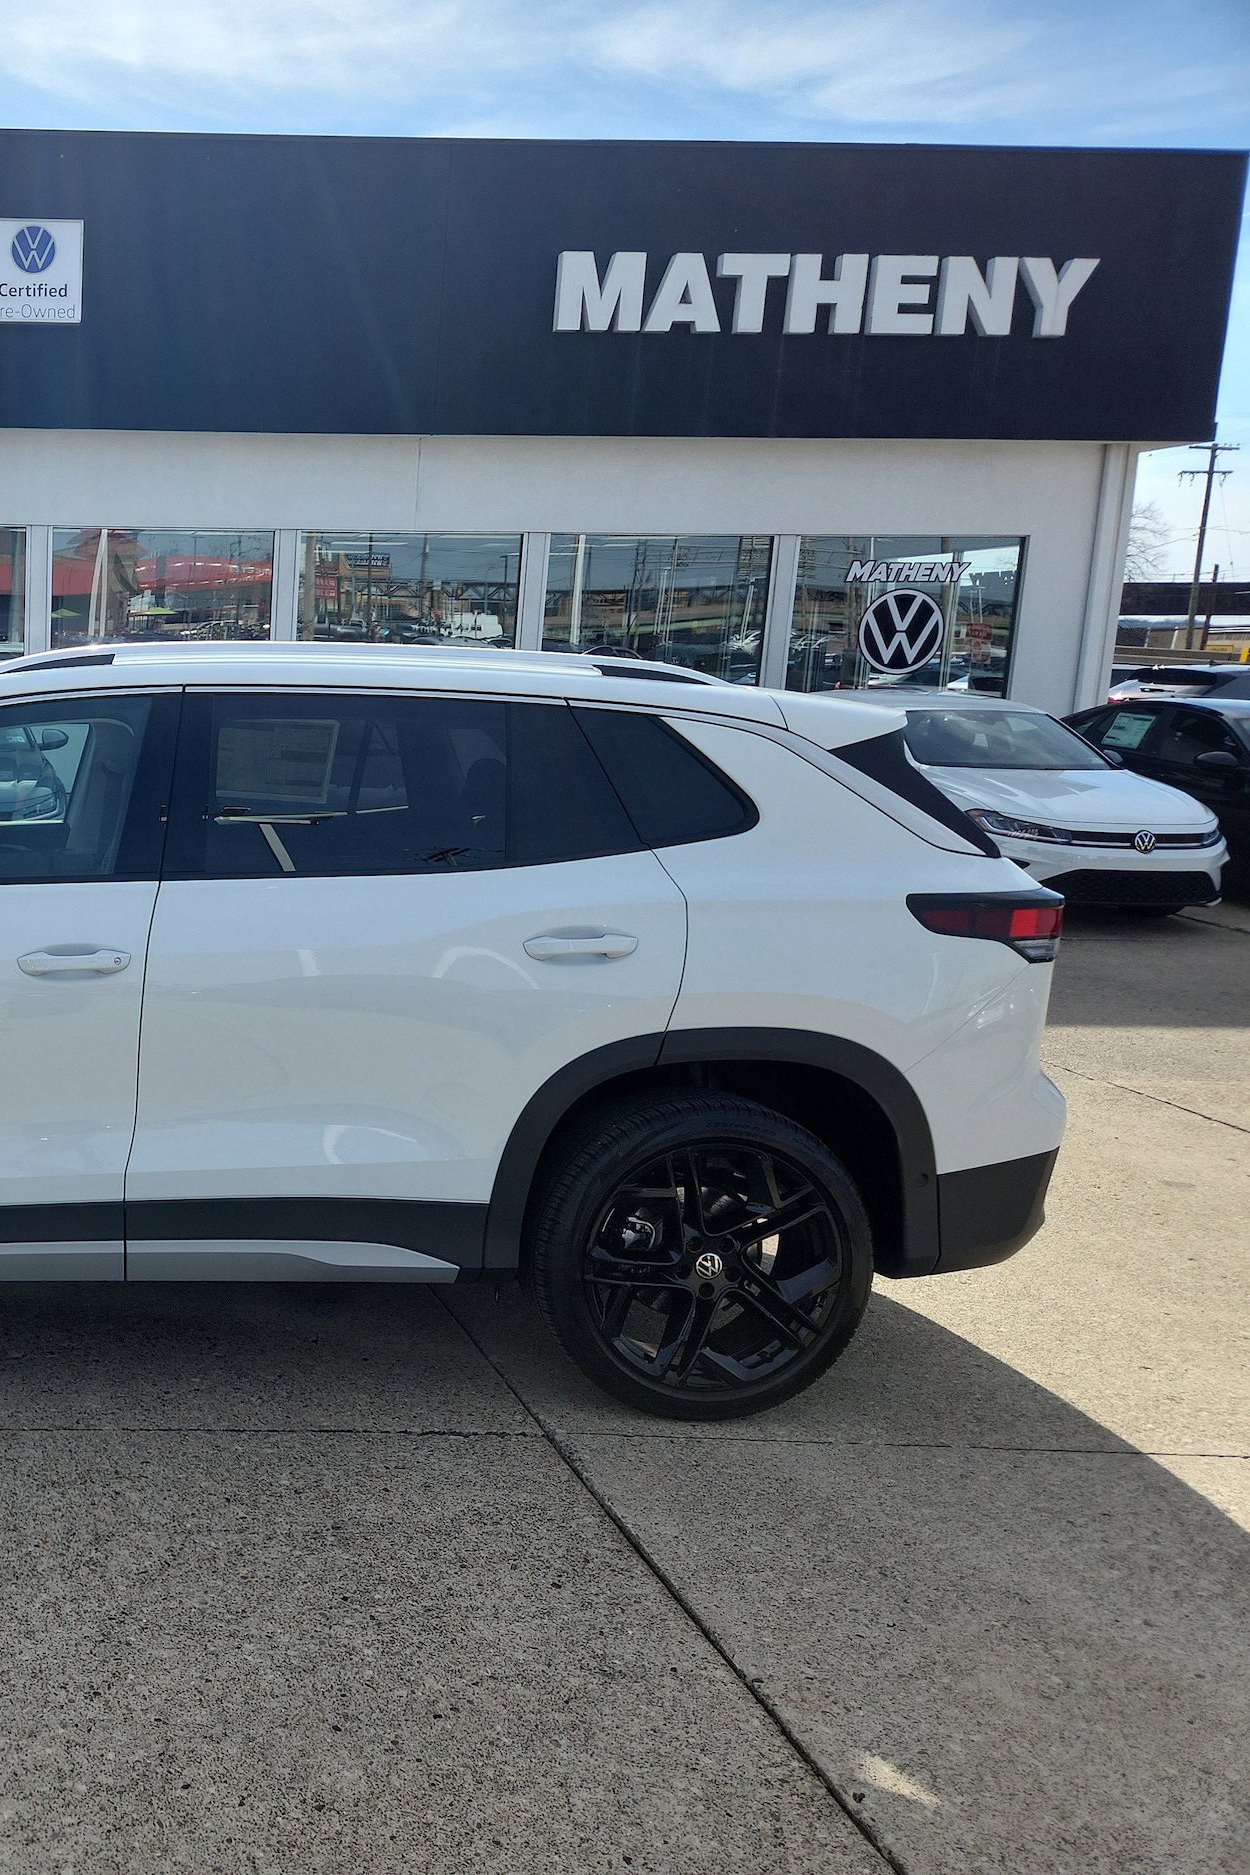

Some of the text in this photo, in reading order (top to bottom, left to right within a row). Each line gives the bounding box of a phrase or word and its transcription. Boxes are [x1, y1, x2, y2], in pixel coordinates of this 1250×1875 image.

[553, 250, 1101, 338] MATHENY
[845, 560, 972, 583] MATHENY
[859, 588, 944, 675] VW
